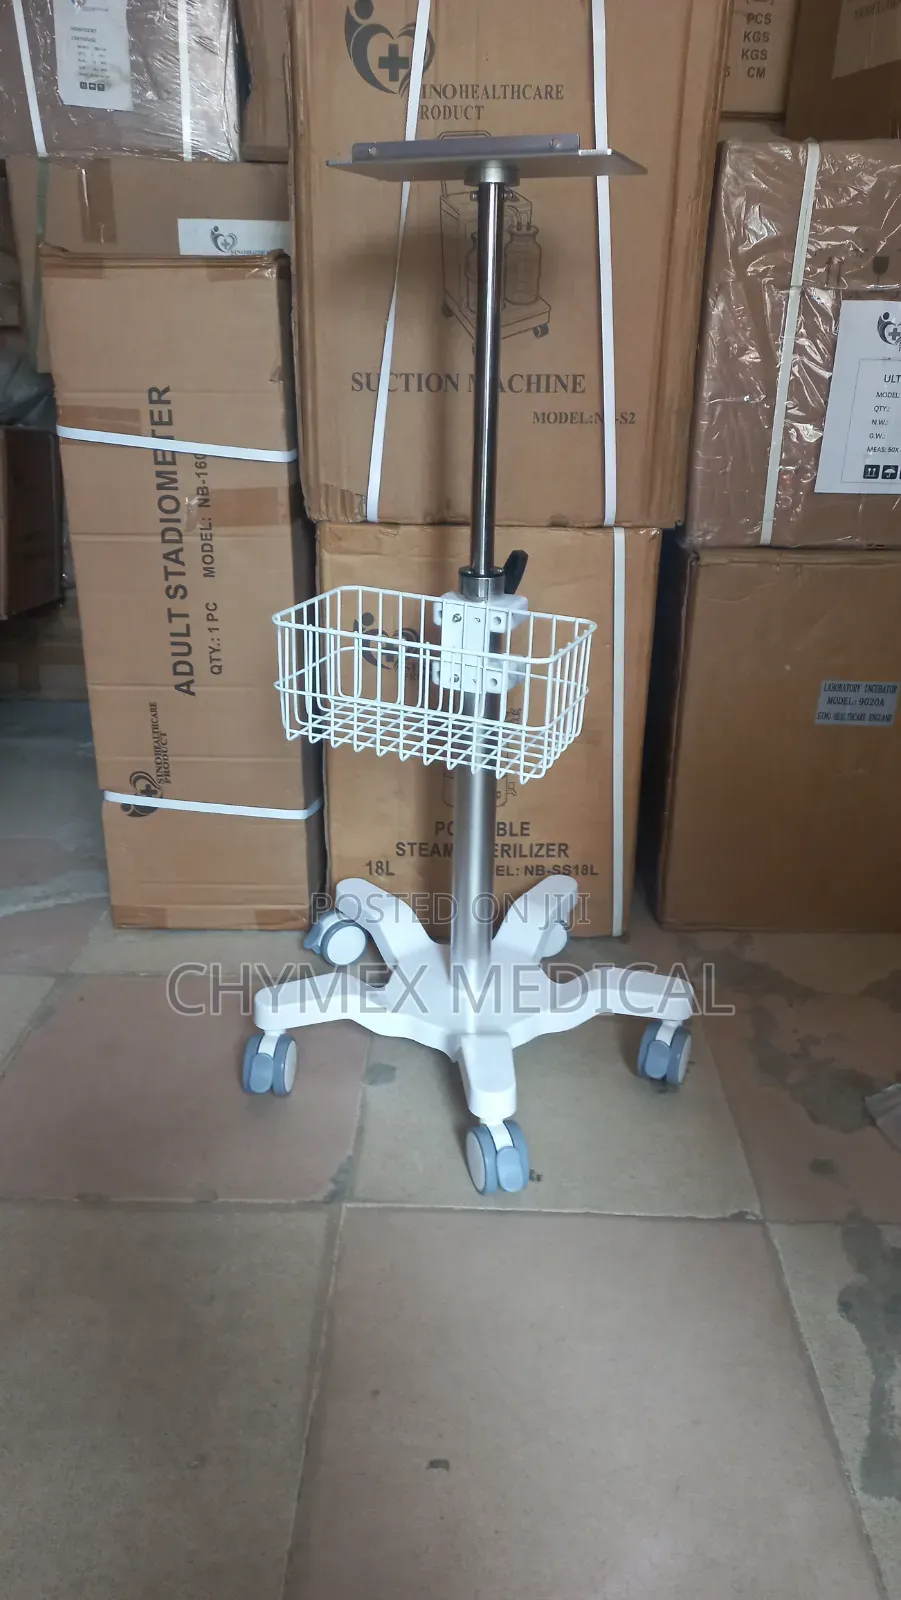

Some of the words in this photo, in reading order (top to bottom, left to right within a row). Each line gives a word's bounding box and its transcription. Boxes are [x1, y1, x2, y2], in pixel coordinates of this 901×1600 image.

[746, 13, 772, 25] PCS
[743, 30, 770, 43] KGS
[741, 48, 768, 61] KGS
[747, 67, 766, 78] CM
[419, 83, 564, 101] INOHEALTHCARE
[419, 104, 485, 121] RODUCT
[468, 372, 586, 394] CHINE
[532, 411, 636, 425] MODEL:N-S2
[147, 384, 189, 600] STADIOMETER
[200, 517, 215, 578] MODEL:
[205, 601, 219, 622] PC
[166, 607, 197, 698] ADULT
[159, 732, 172, 785] PRODUCT
[365, 860, 395, 876] 18L
[524, 864, 599, 876] NB-SS18L
